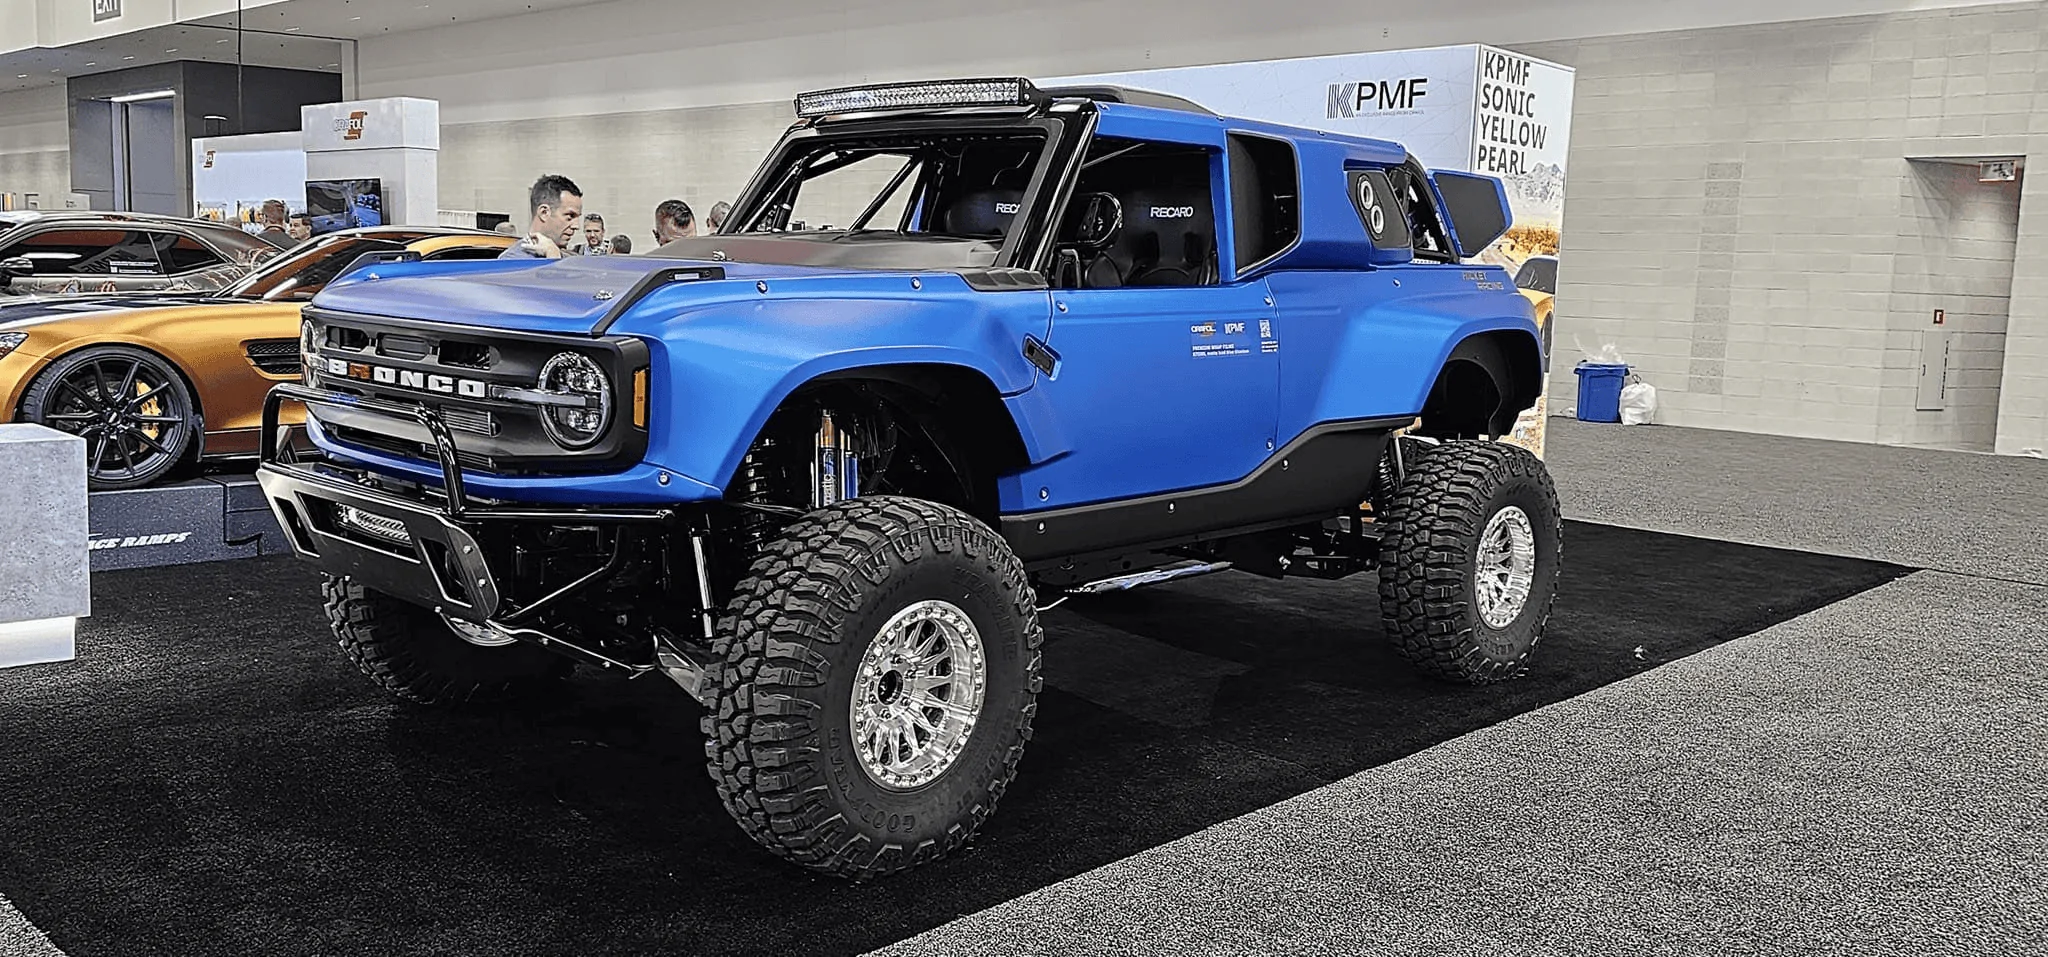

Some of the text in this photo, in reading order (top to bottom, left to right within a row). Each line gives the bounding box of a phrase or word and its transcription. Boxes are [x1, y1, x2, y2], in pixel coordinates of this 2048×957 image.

[1485, 52, 1530, 86] KPMF
[1327, 78, 1427, 119] KPMF
[1481, 83, 1535, 118] SONIC
[1481, 113, 1547, 149] YELLOW
[1477, 144, 1527, 175] PEARL
[996, 203, 1020, 214] REC
[1150, 206, 1193, 218] RECARO
[328, 358, 486, 398] BRONCO
[88, 532, 192, 551] ACE RAMPS
